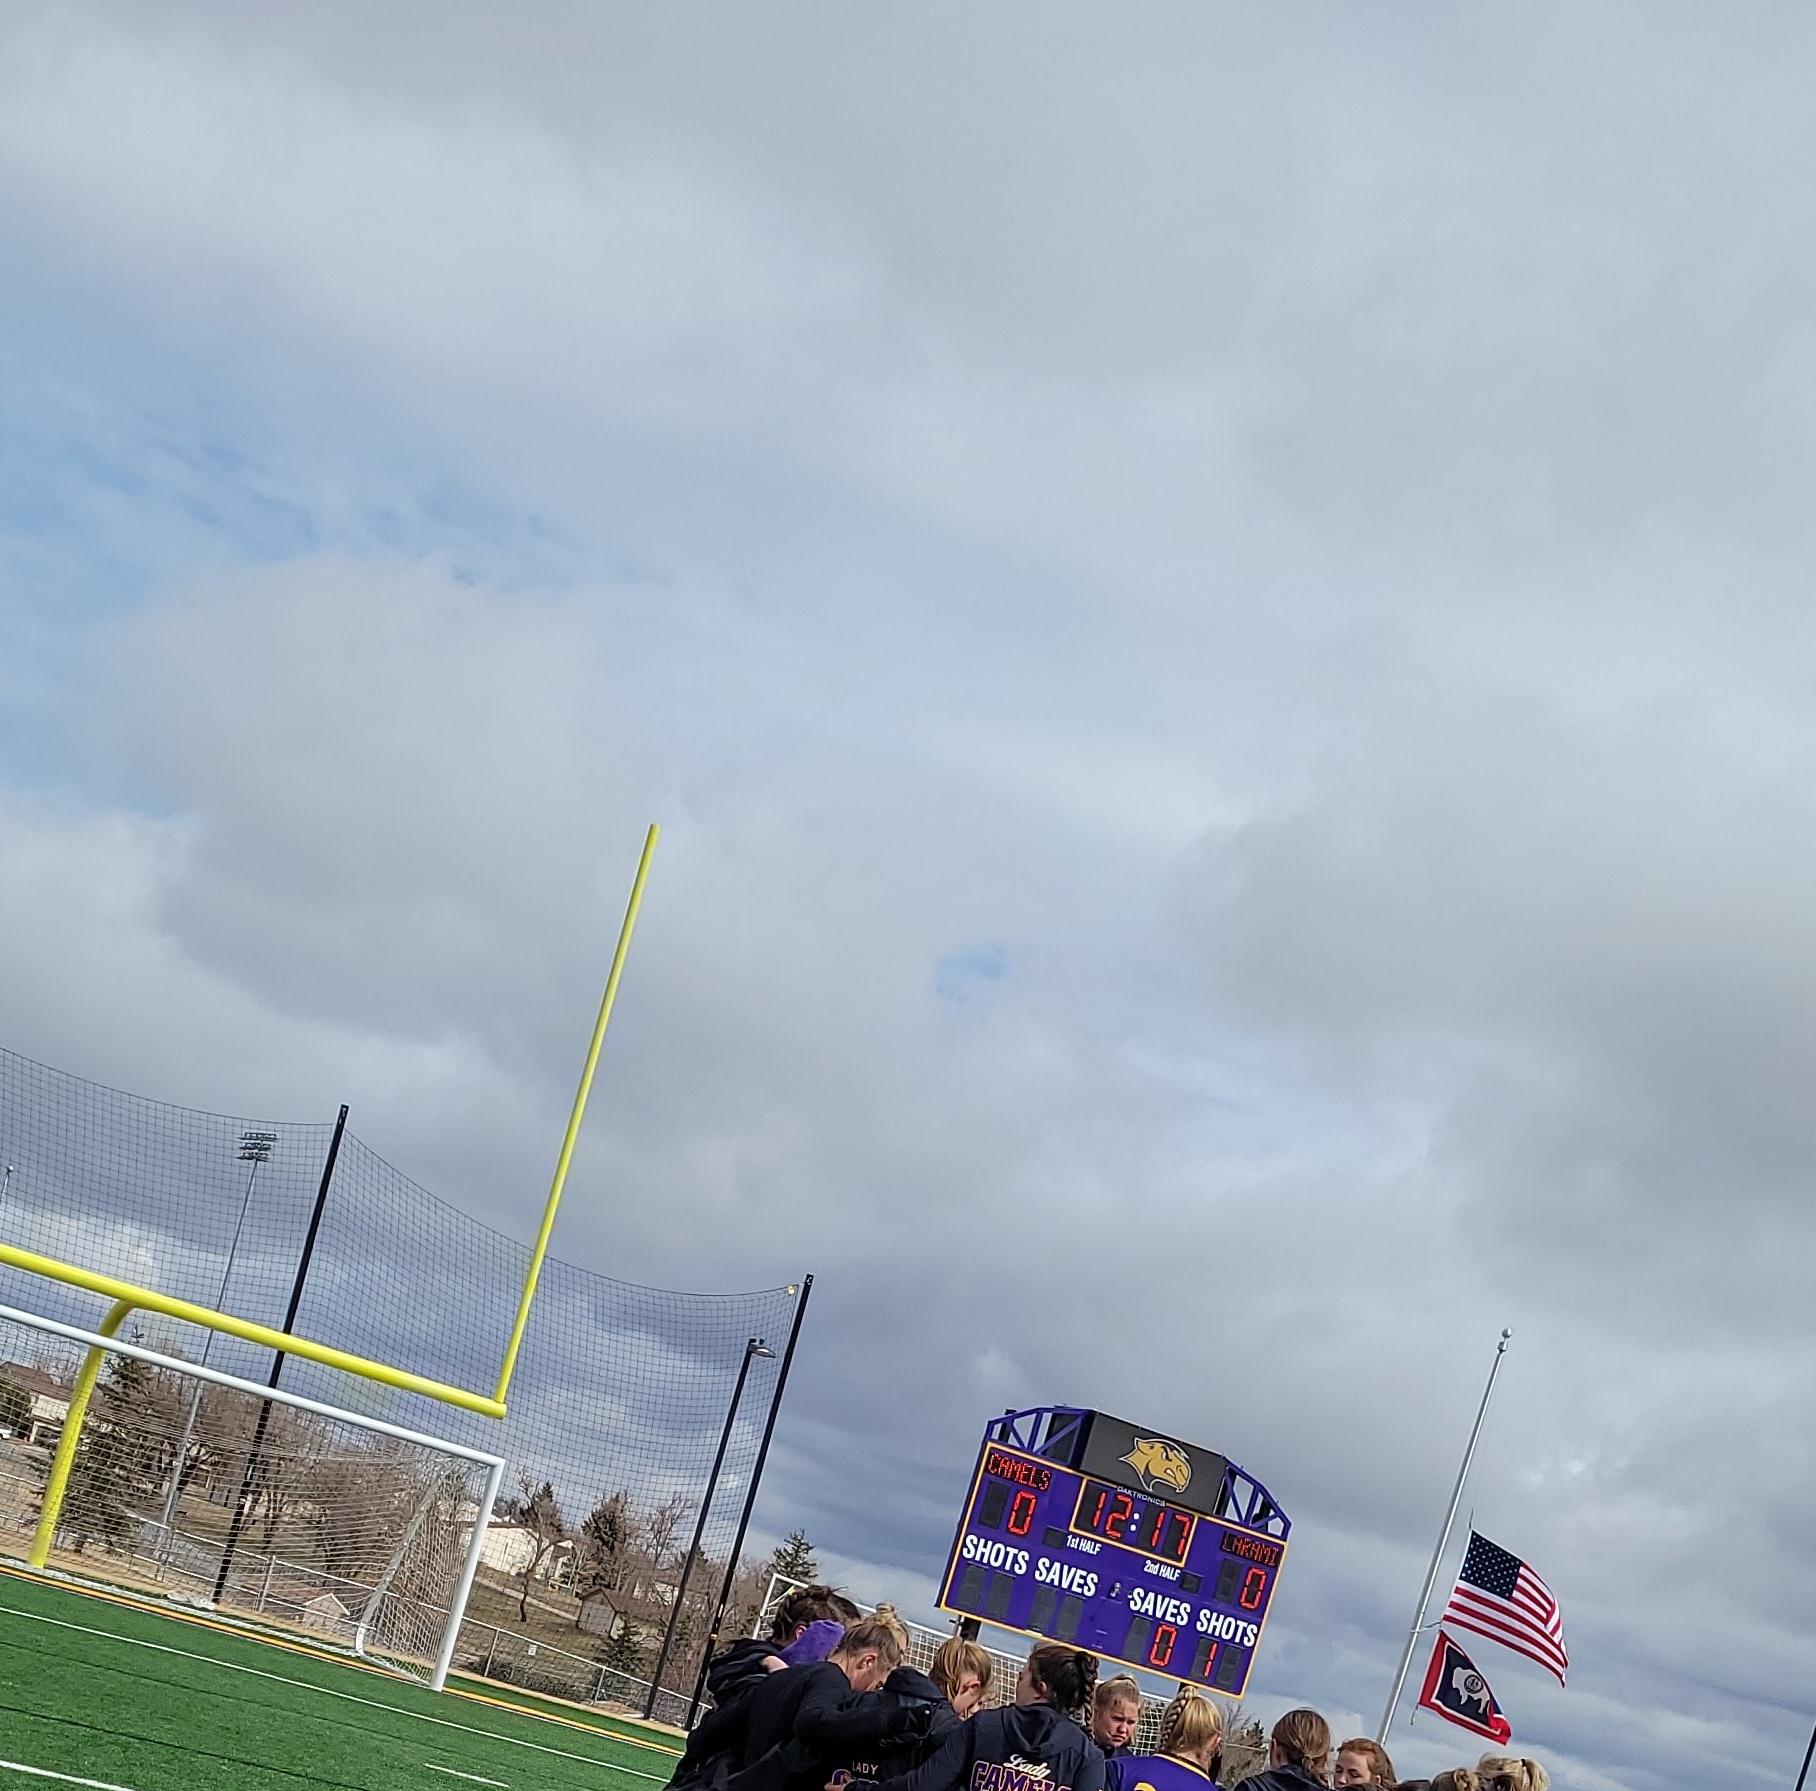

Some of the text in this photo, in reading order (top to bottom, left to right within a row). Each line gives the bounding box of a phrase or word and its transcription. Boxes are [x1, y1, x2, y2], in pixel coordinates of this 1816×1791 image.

[988, 1453, 1051, 1491] CAMELS
[1008, 1490, 1037, 1535] 0
[1116, 1485, 1166, 1507] DAKTRONICS
[1092, 1492, 1191, 1556] 12:17
[1067, 1534, 1102, 1555] 1st HALF
[963, 1534, 1099, 1597] SHOTS SAVES
[1143, 1559, 1181, 1581] 2nd HALF
[1240, 1567, 1267, 1609] 0
[1129, 1587, 1258, 1647] SAVES SHOTS
[1150, 1623, 1178, 1667] 0
[1204, 1642, 1217, 1680] 1
[852, 1760, 879, 1775] LADY
[1003, 1754, 1051, 1780] Lady
